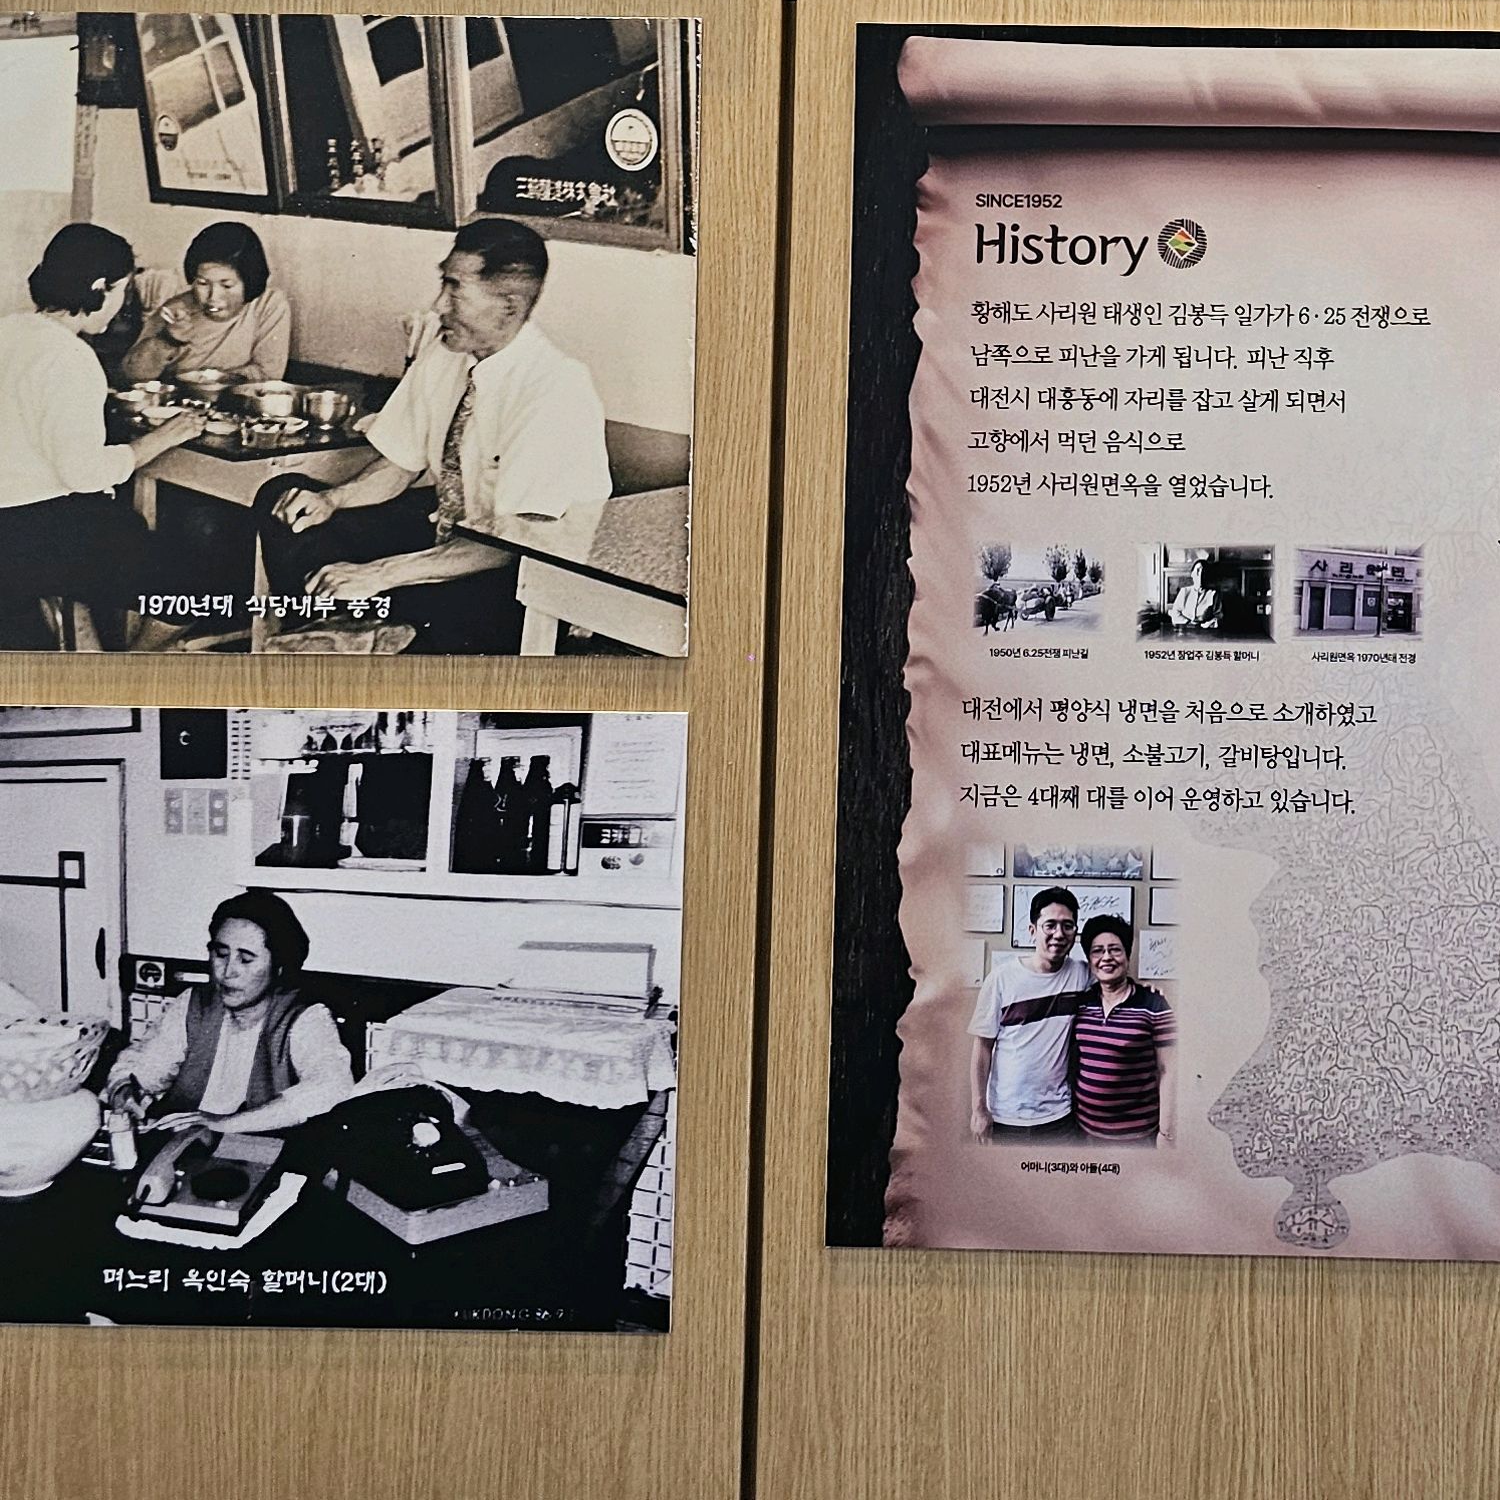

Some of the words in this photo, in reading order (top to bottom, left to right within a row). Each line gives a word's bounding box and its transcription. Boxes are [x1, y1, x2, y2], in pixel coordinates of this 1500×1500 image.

[975, 193, 1063, 209] SINCE1952
[974, 221, 1149, 277] History
[970, 300, 1034, 325] 황해도
[1035, 301, 1097, 326] 사리원
[1102, 301, 1163, 327] 태생인
[1168, 302, 1230, 327] 김봉득
[1234, 303, 1295, 328] 일가가
[1350, 304, 1432, 330] 전쟁으로
[970, 343, 1054, 368] 남쪽으로
[1058, 343, 1121, 368] 피난을
[1126, 344, 1166, 369] 가게
[1172, 345, 1238, 370] 됩니다.
[1246, 345, 1290, 370] 피난
[1293, 346, 1335, 371] 직후
[969, 385, 1030, 411] 대전시
[1037, 386, 1118, 412] 대흥동에
[1124, 387, 1188, 412] 자리를
[1191, 387, 1234, 412] 잡고
[1237, 388, 1279, 413] 살게
[1285, 388, 1345, 414] 되면서
[967, 428, 1049, 454] 고향에서
[1057, 429, 1097, 454] 먹던
[1102, 429, 1186, 454] 음식으로
[967, 471, 1032, 496] 1952년
[1036, 471, 1163, 498] 사리원면옥을
[1168, 473, 1274, 499] 열었습니다.
[138, 594, 233, 619] 1970년대
[246, 594, 337, 619] 식당내부
[346, 594, 392, 619] 풍경
[989, 647, 1021, 659] 1950년
[1144, 650, 1176, 661] 1952년
[1357, 653, 1397, 664] 1970년대
[1398, 653, 1417, 665] 전경
[961, 696, 1043, 723] 대전에서
[1049, 697, 1110, 723] 평양식
[1117, 698, 1181, 724] 냉면을
[1184, 699, 1269, 725] 처음으로
[1272, 701, 1378, 728] 소개하였고
[960, 739, 1065, 766] 대표메뉴는
[1069, 741, 1115, 769] 냉면,
[1122, 742, 1210, 771] 소불고기,
[1218, 743, 1346, 771] 갈비탕입니다.
[959, 782, 1023, 809] 지금은
[1027, 784, 1080, 810] 4대째
[1086, 785, 1129, 810] 대를
[1134, 785, 1174, 812] 이어
[1179, 786, 1265, 813] 운영하고
[1270, 788, 1356, 815] 있습니다.
[1020, 1161, 1079, 1175] 어머니(3대)와
[102, 1267, 170, 1292] 며느리
[182, 1268, 251, 1293] 옥인숙
[261, 1269, 387, 1295] 할머니(2대)
